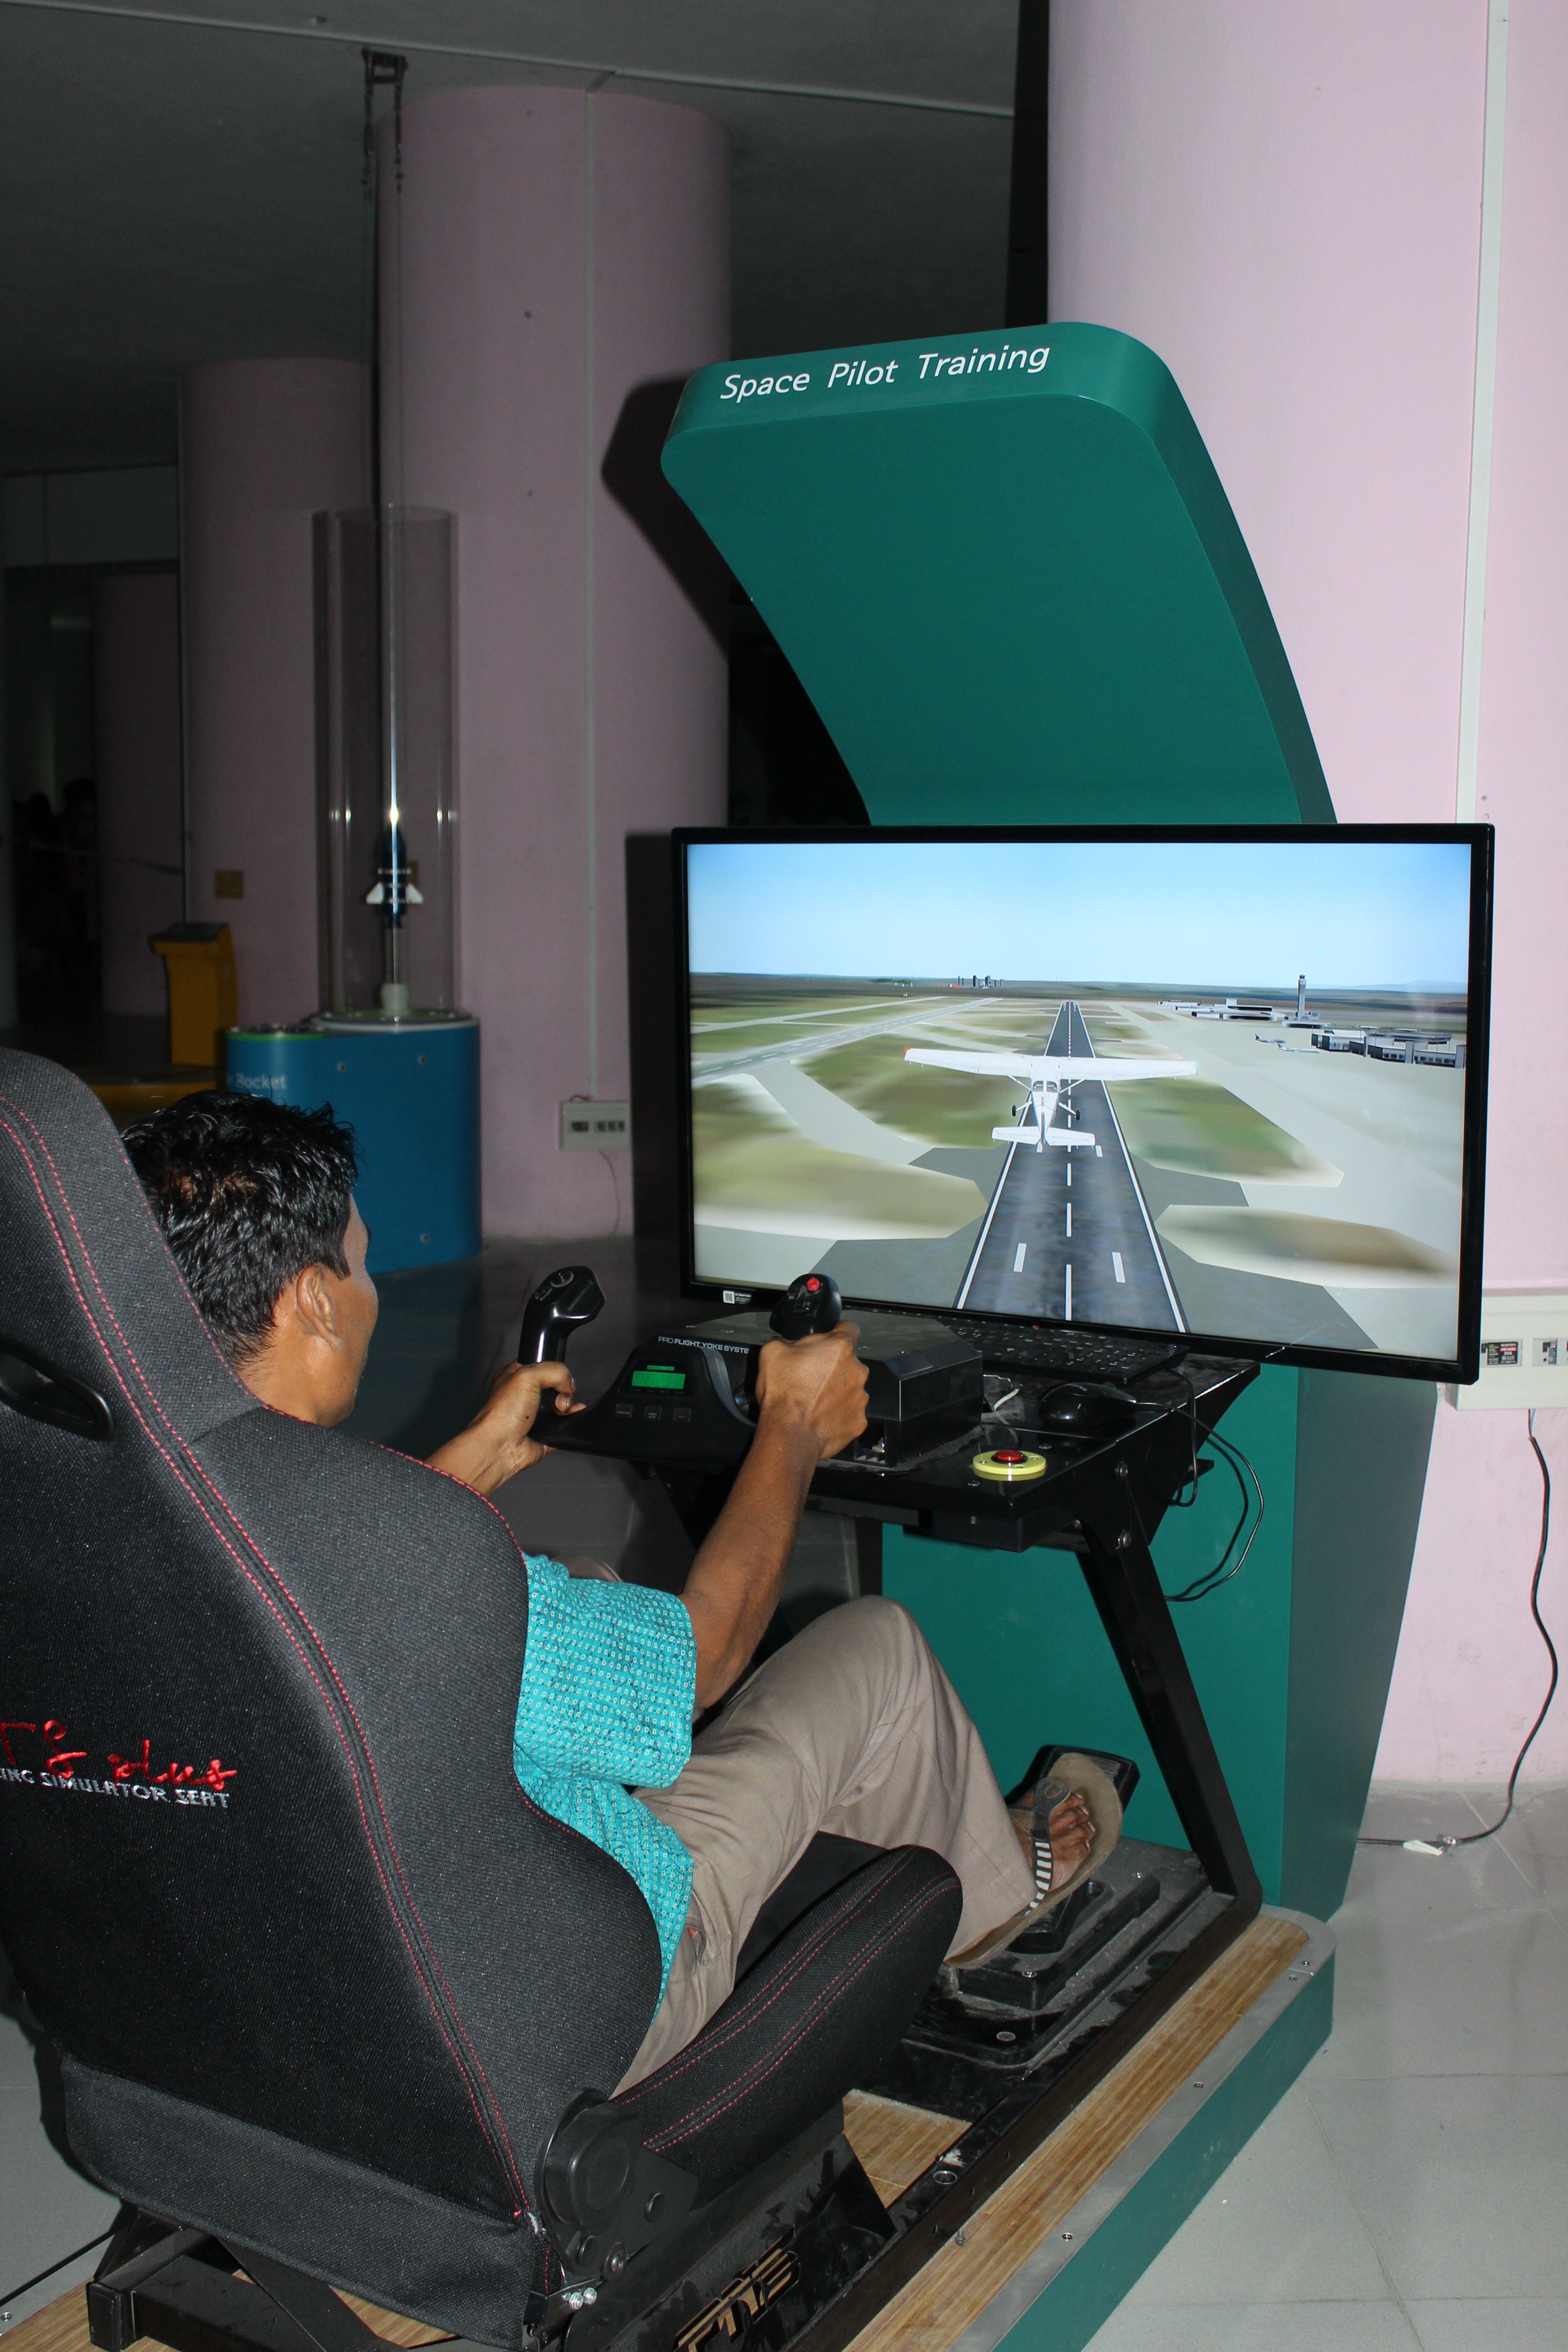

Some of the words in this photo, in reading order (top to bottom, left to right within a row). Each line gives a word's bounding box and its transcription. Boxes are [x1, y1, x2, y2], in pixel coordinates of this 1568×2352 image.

[720, 373, 810, 403] Space
[827, 360, 899, 388] Pilot
[918, 344, 1050, 379] Training
[236, 1073, 286, 1089] Rocket
[674, 1338, 701, 1347] FLIGHT
[702, 1342, 723, 1351] YOKE
[108, 1739, 237, 1791] plus
[0, 1768, 34, 1784] ING
[40, 1772, 168, 1803] SIMULATOR
[175, 1788, 230, 1808] SEAT
